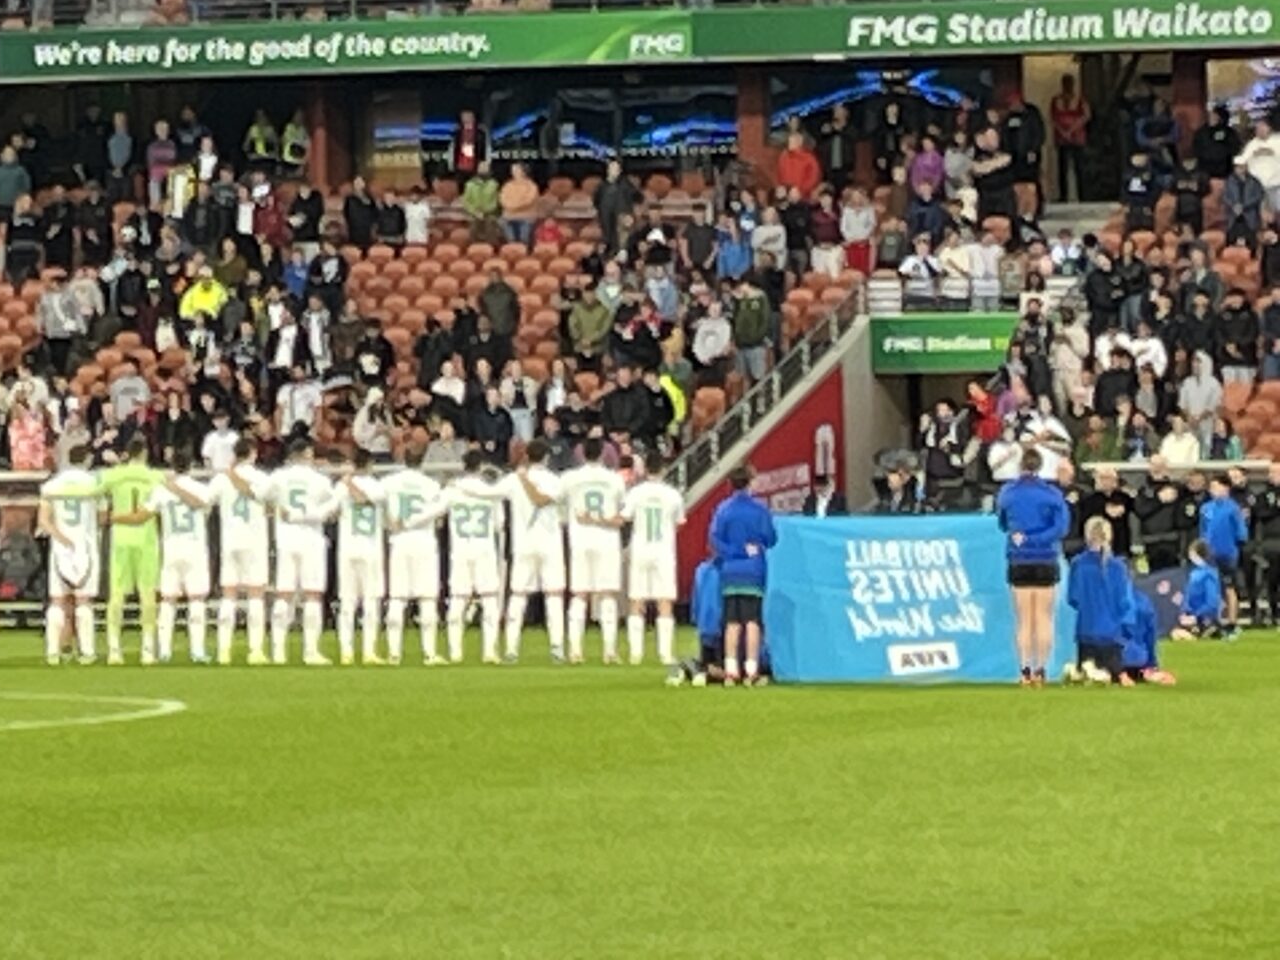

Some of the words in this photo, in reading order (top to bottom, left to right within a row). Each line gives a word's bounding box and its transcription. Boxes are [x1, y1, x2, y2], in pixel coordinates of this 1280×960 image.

[848, 14, 939, 47] FMG
[946, 6, 1104, 44] Stadium
[1113, 2, 1273, 38] Waikato
[34, 40, 102, 66] We're
[107, 40, 160, 64] here
[162, 38, 201, 68] for
[205, 37, 245, 61] the
[249, 34, 311, 65] good
[314, 32, 343, 63] of
[345, 33, 386, 57] the
[232, 494, 251, 523] 4
[453, 502, 491, 538] 23
[644, 507, 663, 542] 11
